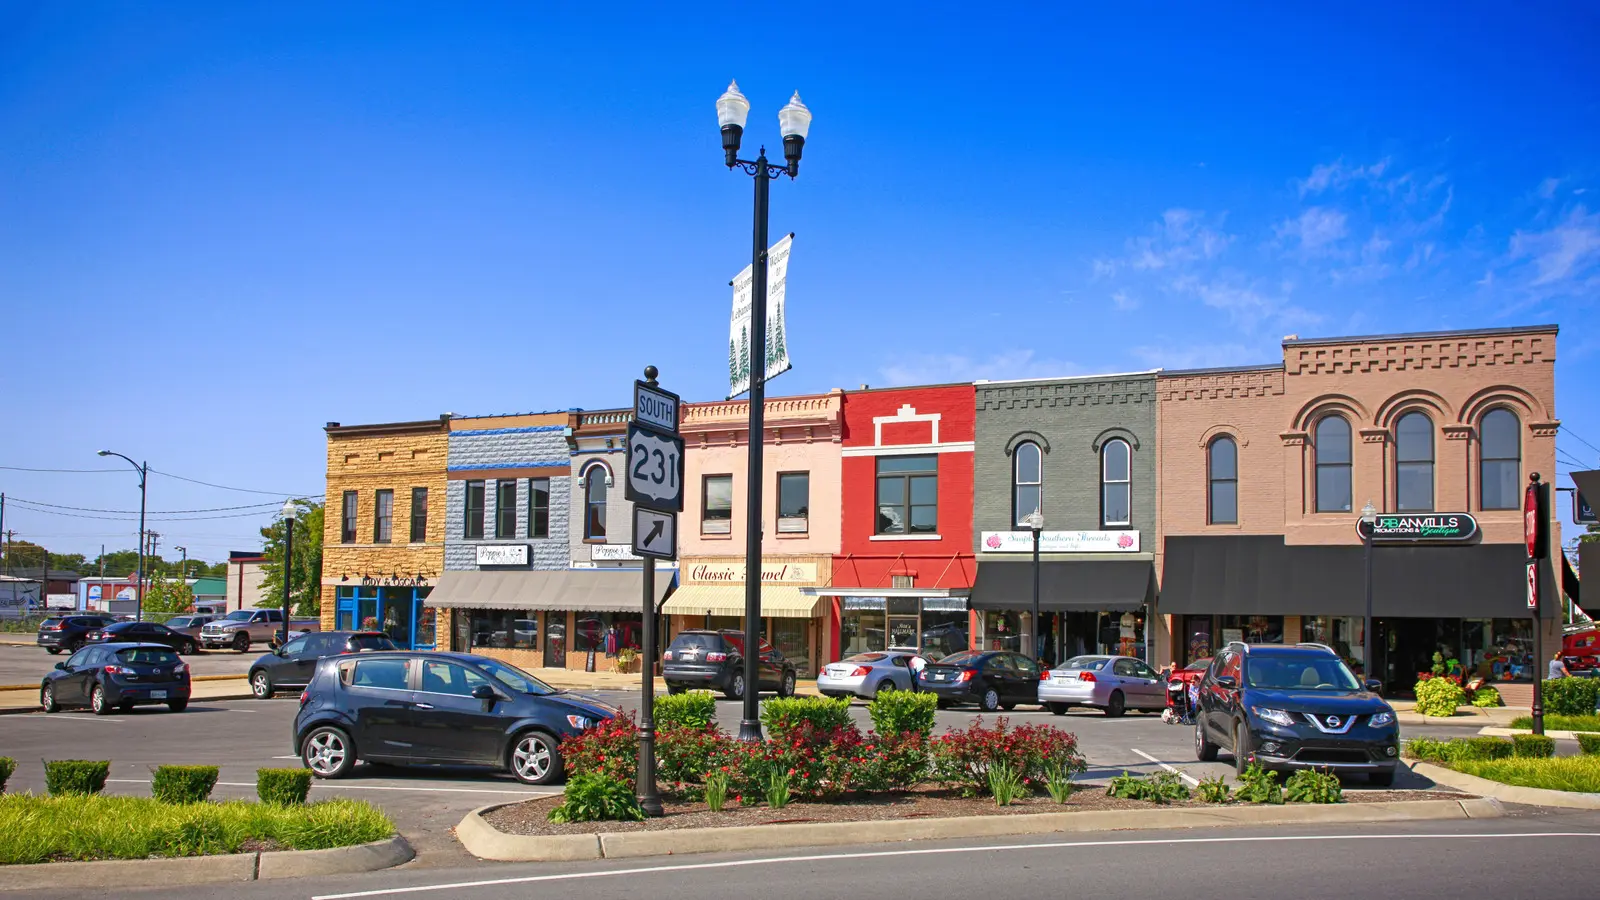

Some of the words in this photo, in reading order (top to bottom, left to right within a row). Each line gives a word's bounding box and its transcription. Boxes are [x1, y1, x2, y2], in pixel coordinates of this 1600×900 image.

[734, 276, 752, 294] Welcom
[639, 395, 673, 422] SOUTH
[633, 443, 675, 488] 231
[1077, 531, 1111, 542] Threads
[692, 564, 735, 580] Classic
